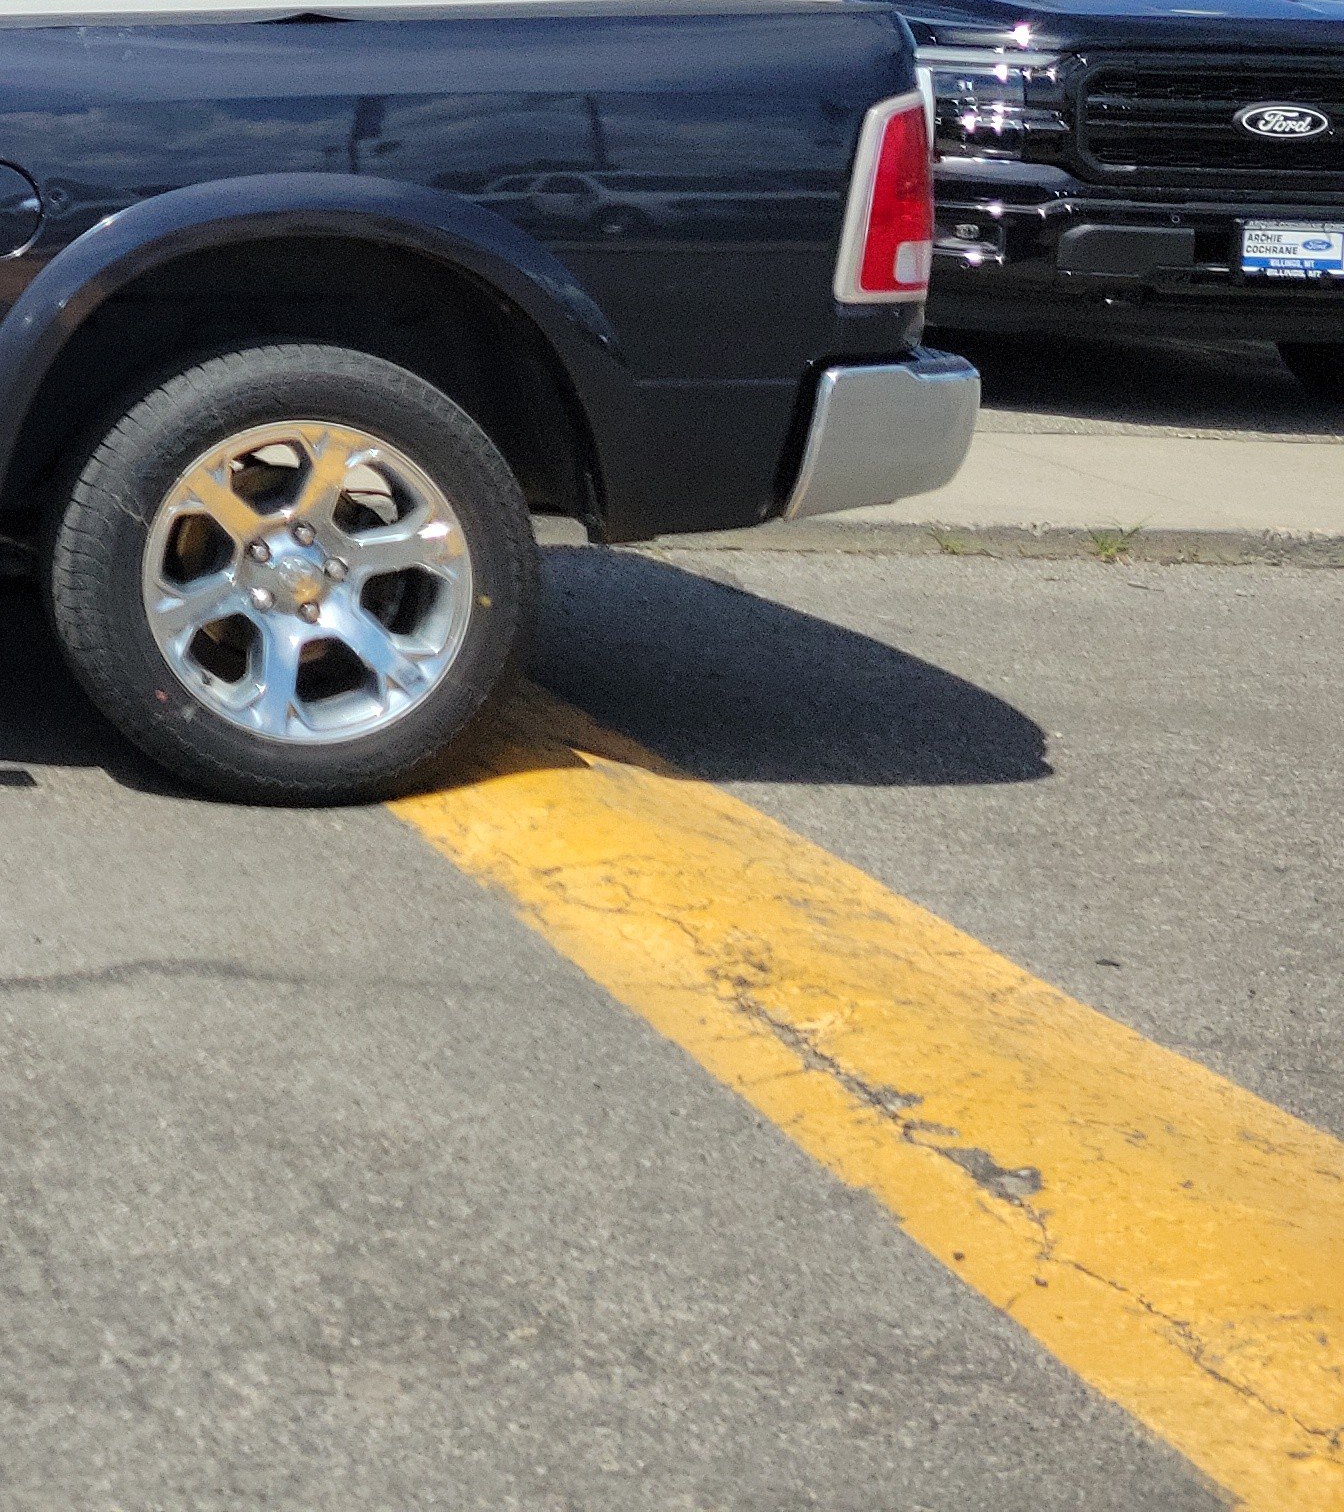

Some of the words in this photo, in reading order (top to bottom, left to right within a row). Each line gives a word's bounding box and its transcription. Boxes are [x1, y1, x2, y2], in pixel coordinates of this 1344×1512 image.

[1257, 111, 1312, 132] Ford
[1247, 233, 1283, 243] ARCHIE
[1245, 245, 1299, 255] COCHRANE
